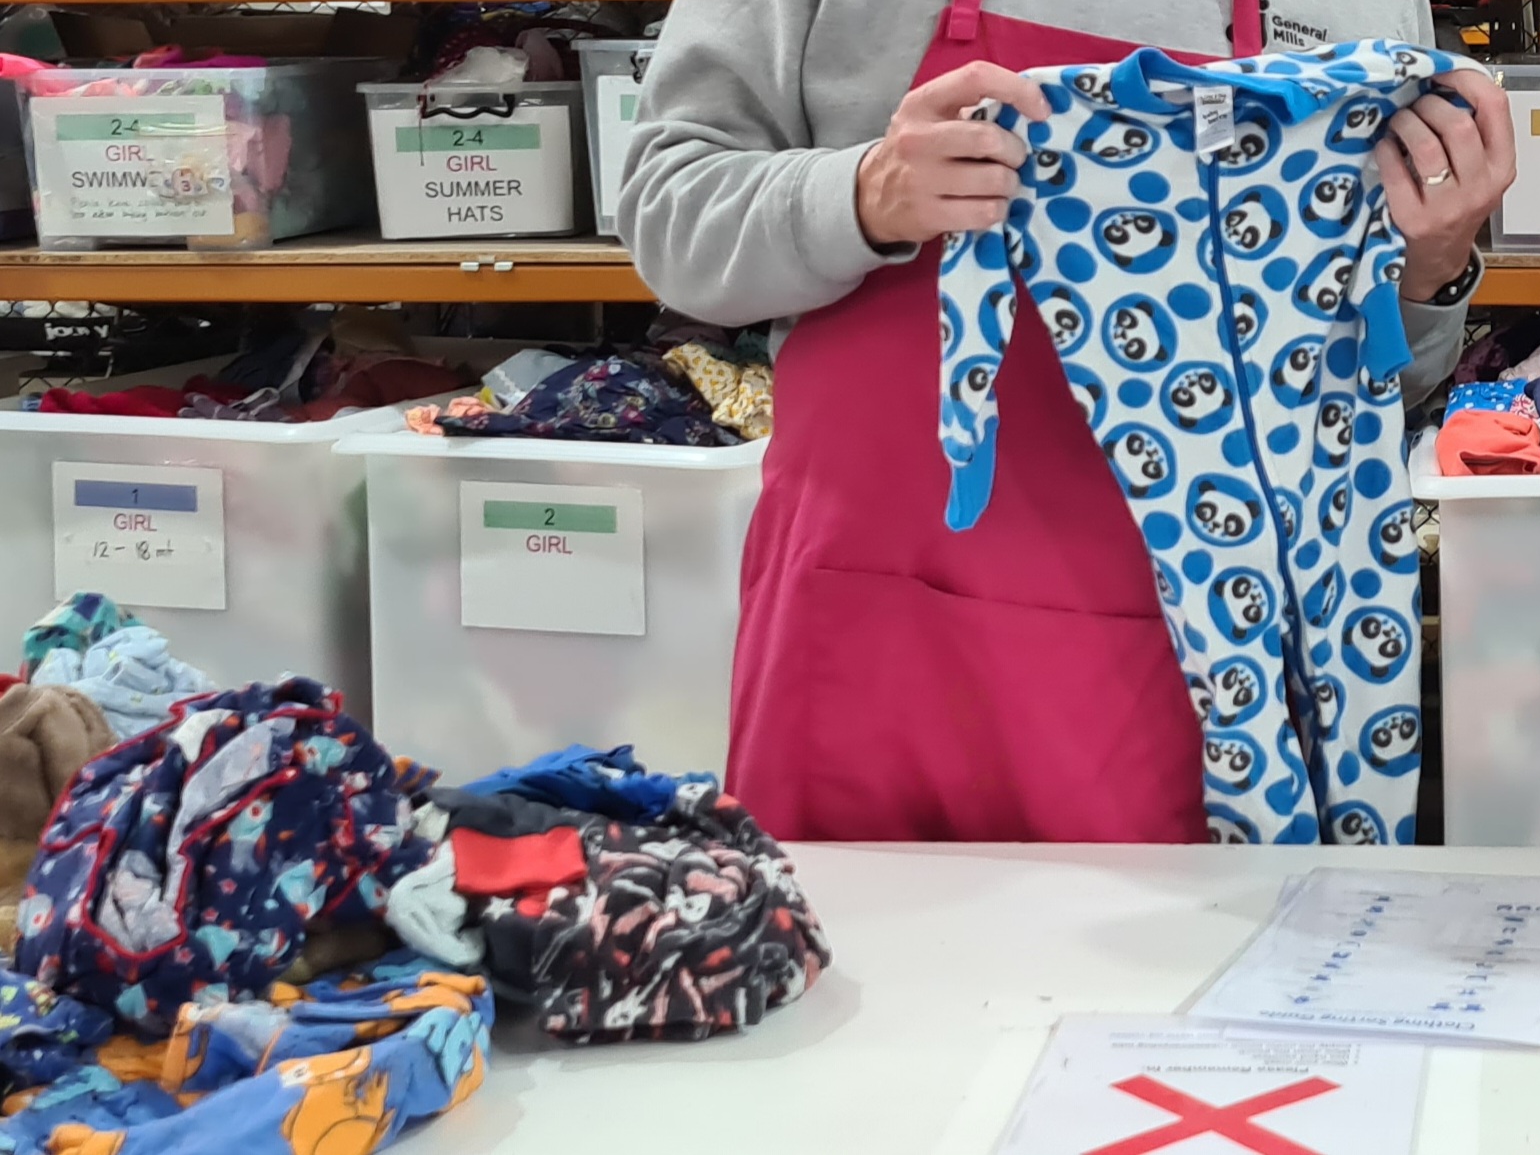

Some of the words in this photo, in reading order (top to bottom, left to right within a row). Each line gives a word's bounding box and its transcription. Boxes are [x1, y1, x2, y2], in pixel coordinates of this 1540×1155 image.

[1272, 16, 1327, 42] General
[1273, 28, 1305, 46] Mills
[452, 129, 484, 146] 2-4
[446, 154, 498, 172] GIRL
[424, 180, 523, 198] SUMMER
[446, 205, 504, 222] HATS
[132, 489, 138, 504] 1
[114, 513, 157, 531] GIRL
[544, 508, 555, 526] 2
[526, 535, 572, 555] GIRL
